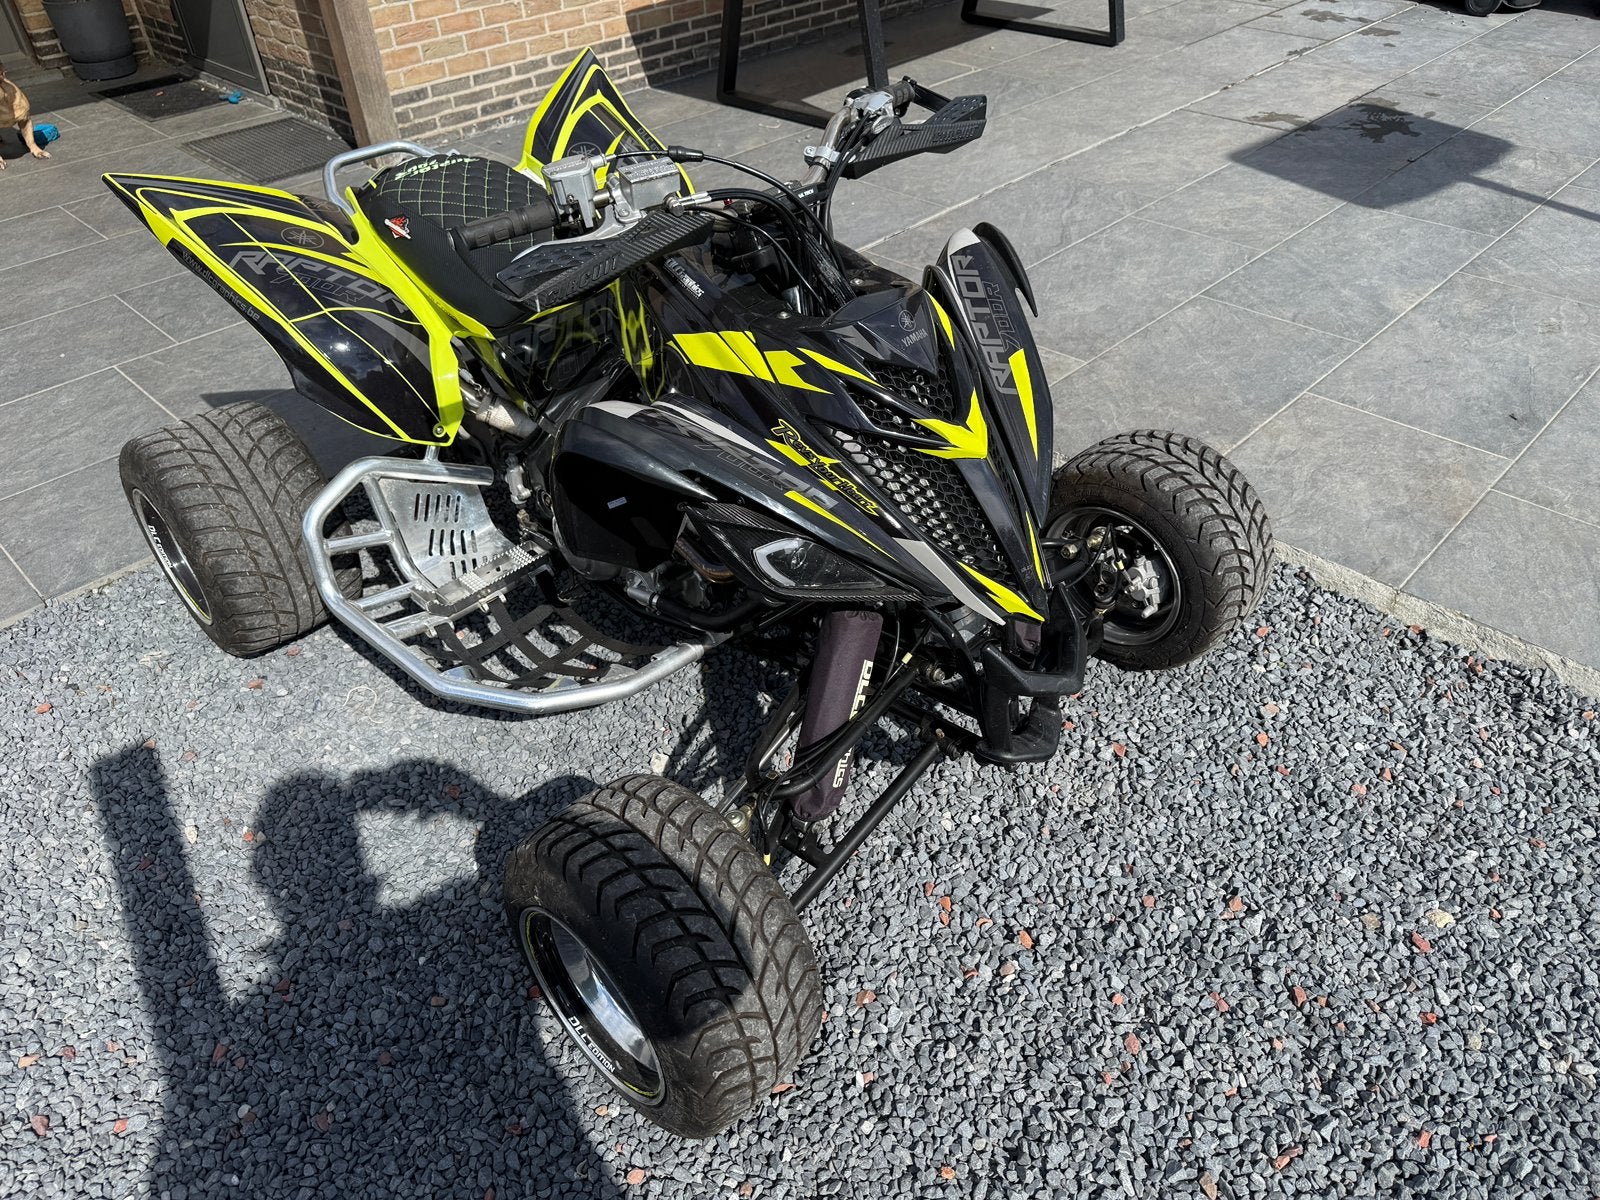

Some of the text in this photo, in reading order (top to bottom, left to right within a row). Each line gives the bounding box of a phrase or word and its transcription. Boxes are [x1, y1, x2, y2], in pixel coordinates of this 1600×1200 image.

[901, 328, 928, 347] YAMAHA
[951, 254, 1019, 394] RAPTOR
[568, 1015, 615, 1073] DLC EDITION
